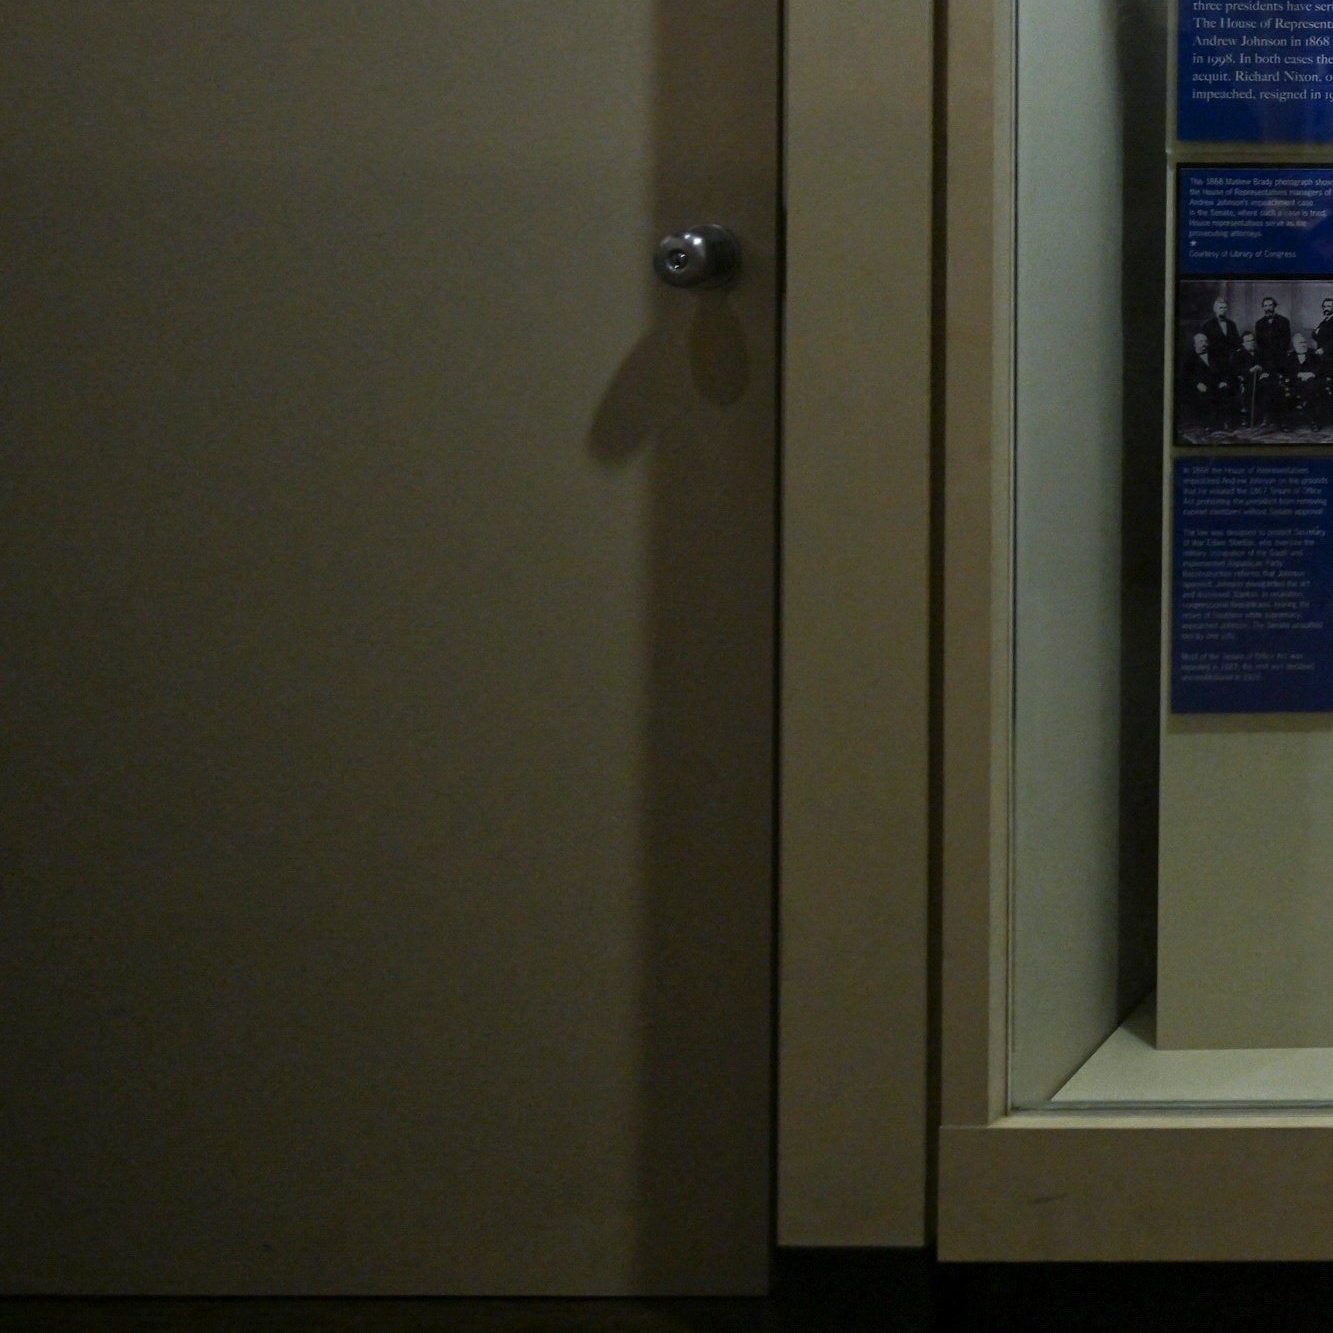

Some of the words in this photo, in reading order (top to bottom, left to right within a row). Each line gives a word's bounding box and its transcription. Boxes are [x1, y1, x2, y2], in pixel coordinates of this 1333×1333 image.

[1193, 0, 1222, 10] three
[1225, 0, 1283, 14] presidents
[1286, 0, 1312, 11] have
[1194, 16, 1216, 28] The
[1220, 17, 1256, 28] House
[1259, 17, 1272, 28] of
[1193, 34, 1236, 46] Andrew
[1240, 35, 1286, 46] Johnson
[1290, 35, 1301, 46] in
[1305, 35, 1329, 46] 1868
[1193, 52, 1203, 63] in
[1239, 52, 1251, 64] In
[1254, 52, 1280, 64] both
[1283, 56, 1313, 64] cases
[1316, 53, 1333, 64] the
[1259, 88, 1306, 102] resigned
[1310, 88, 1321, 99] in
